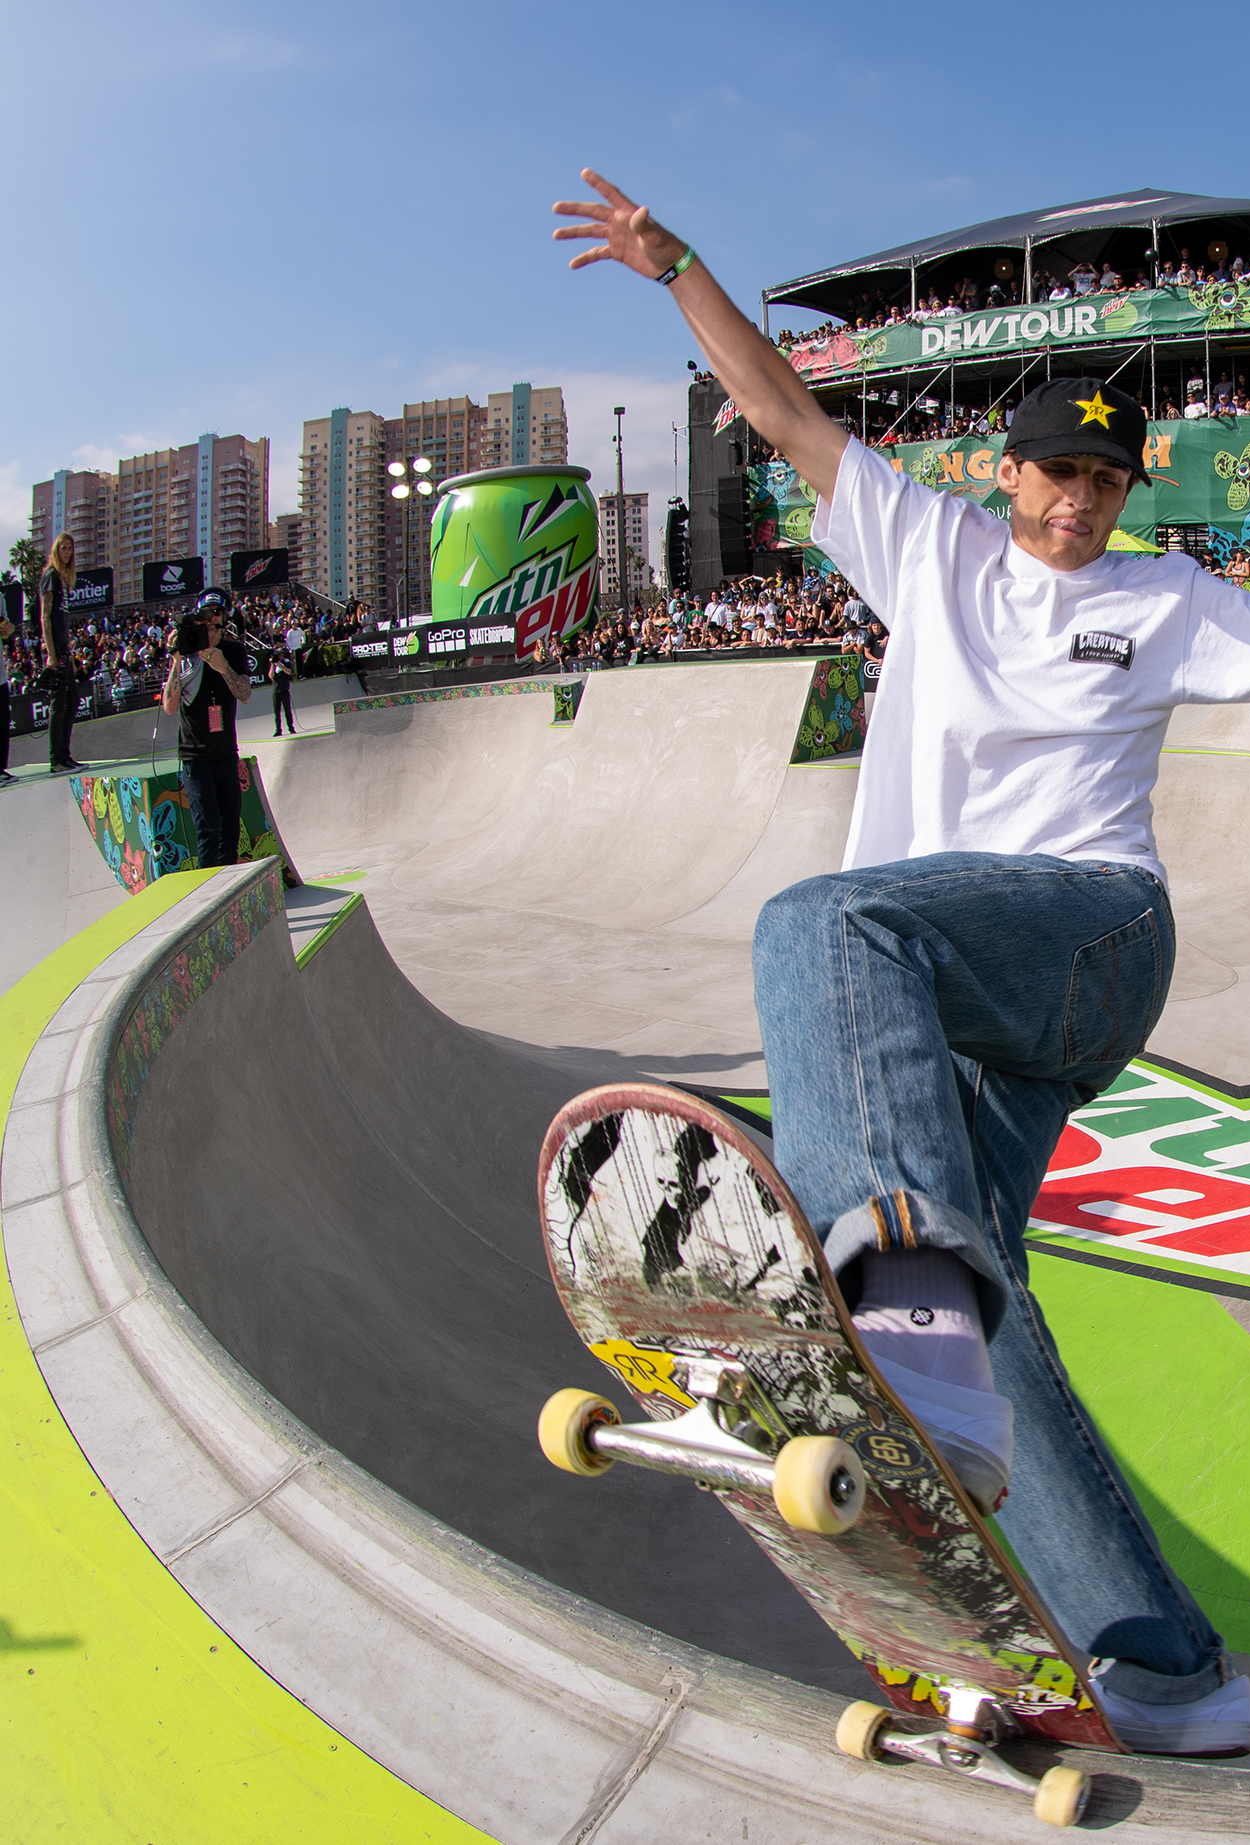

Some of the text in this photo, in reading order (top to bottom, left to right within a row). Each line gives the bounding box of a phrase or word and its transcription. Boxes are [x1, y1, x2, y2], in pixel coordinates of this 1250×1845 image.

[69, 585, 109, 601] ontier
[160, 582, 187, 592] boost
[428, 629, 466, 642] GoPro
[352, 642, 388, 654] PRO-TEC
[393, 636, 407, 648] DEW
[1079, 632, 1129, 655] CREATURE
[394, 645, 409, 657] TOUR
